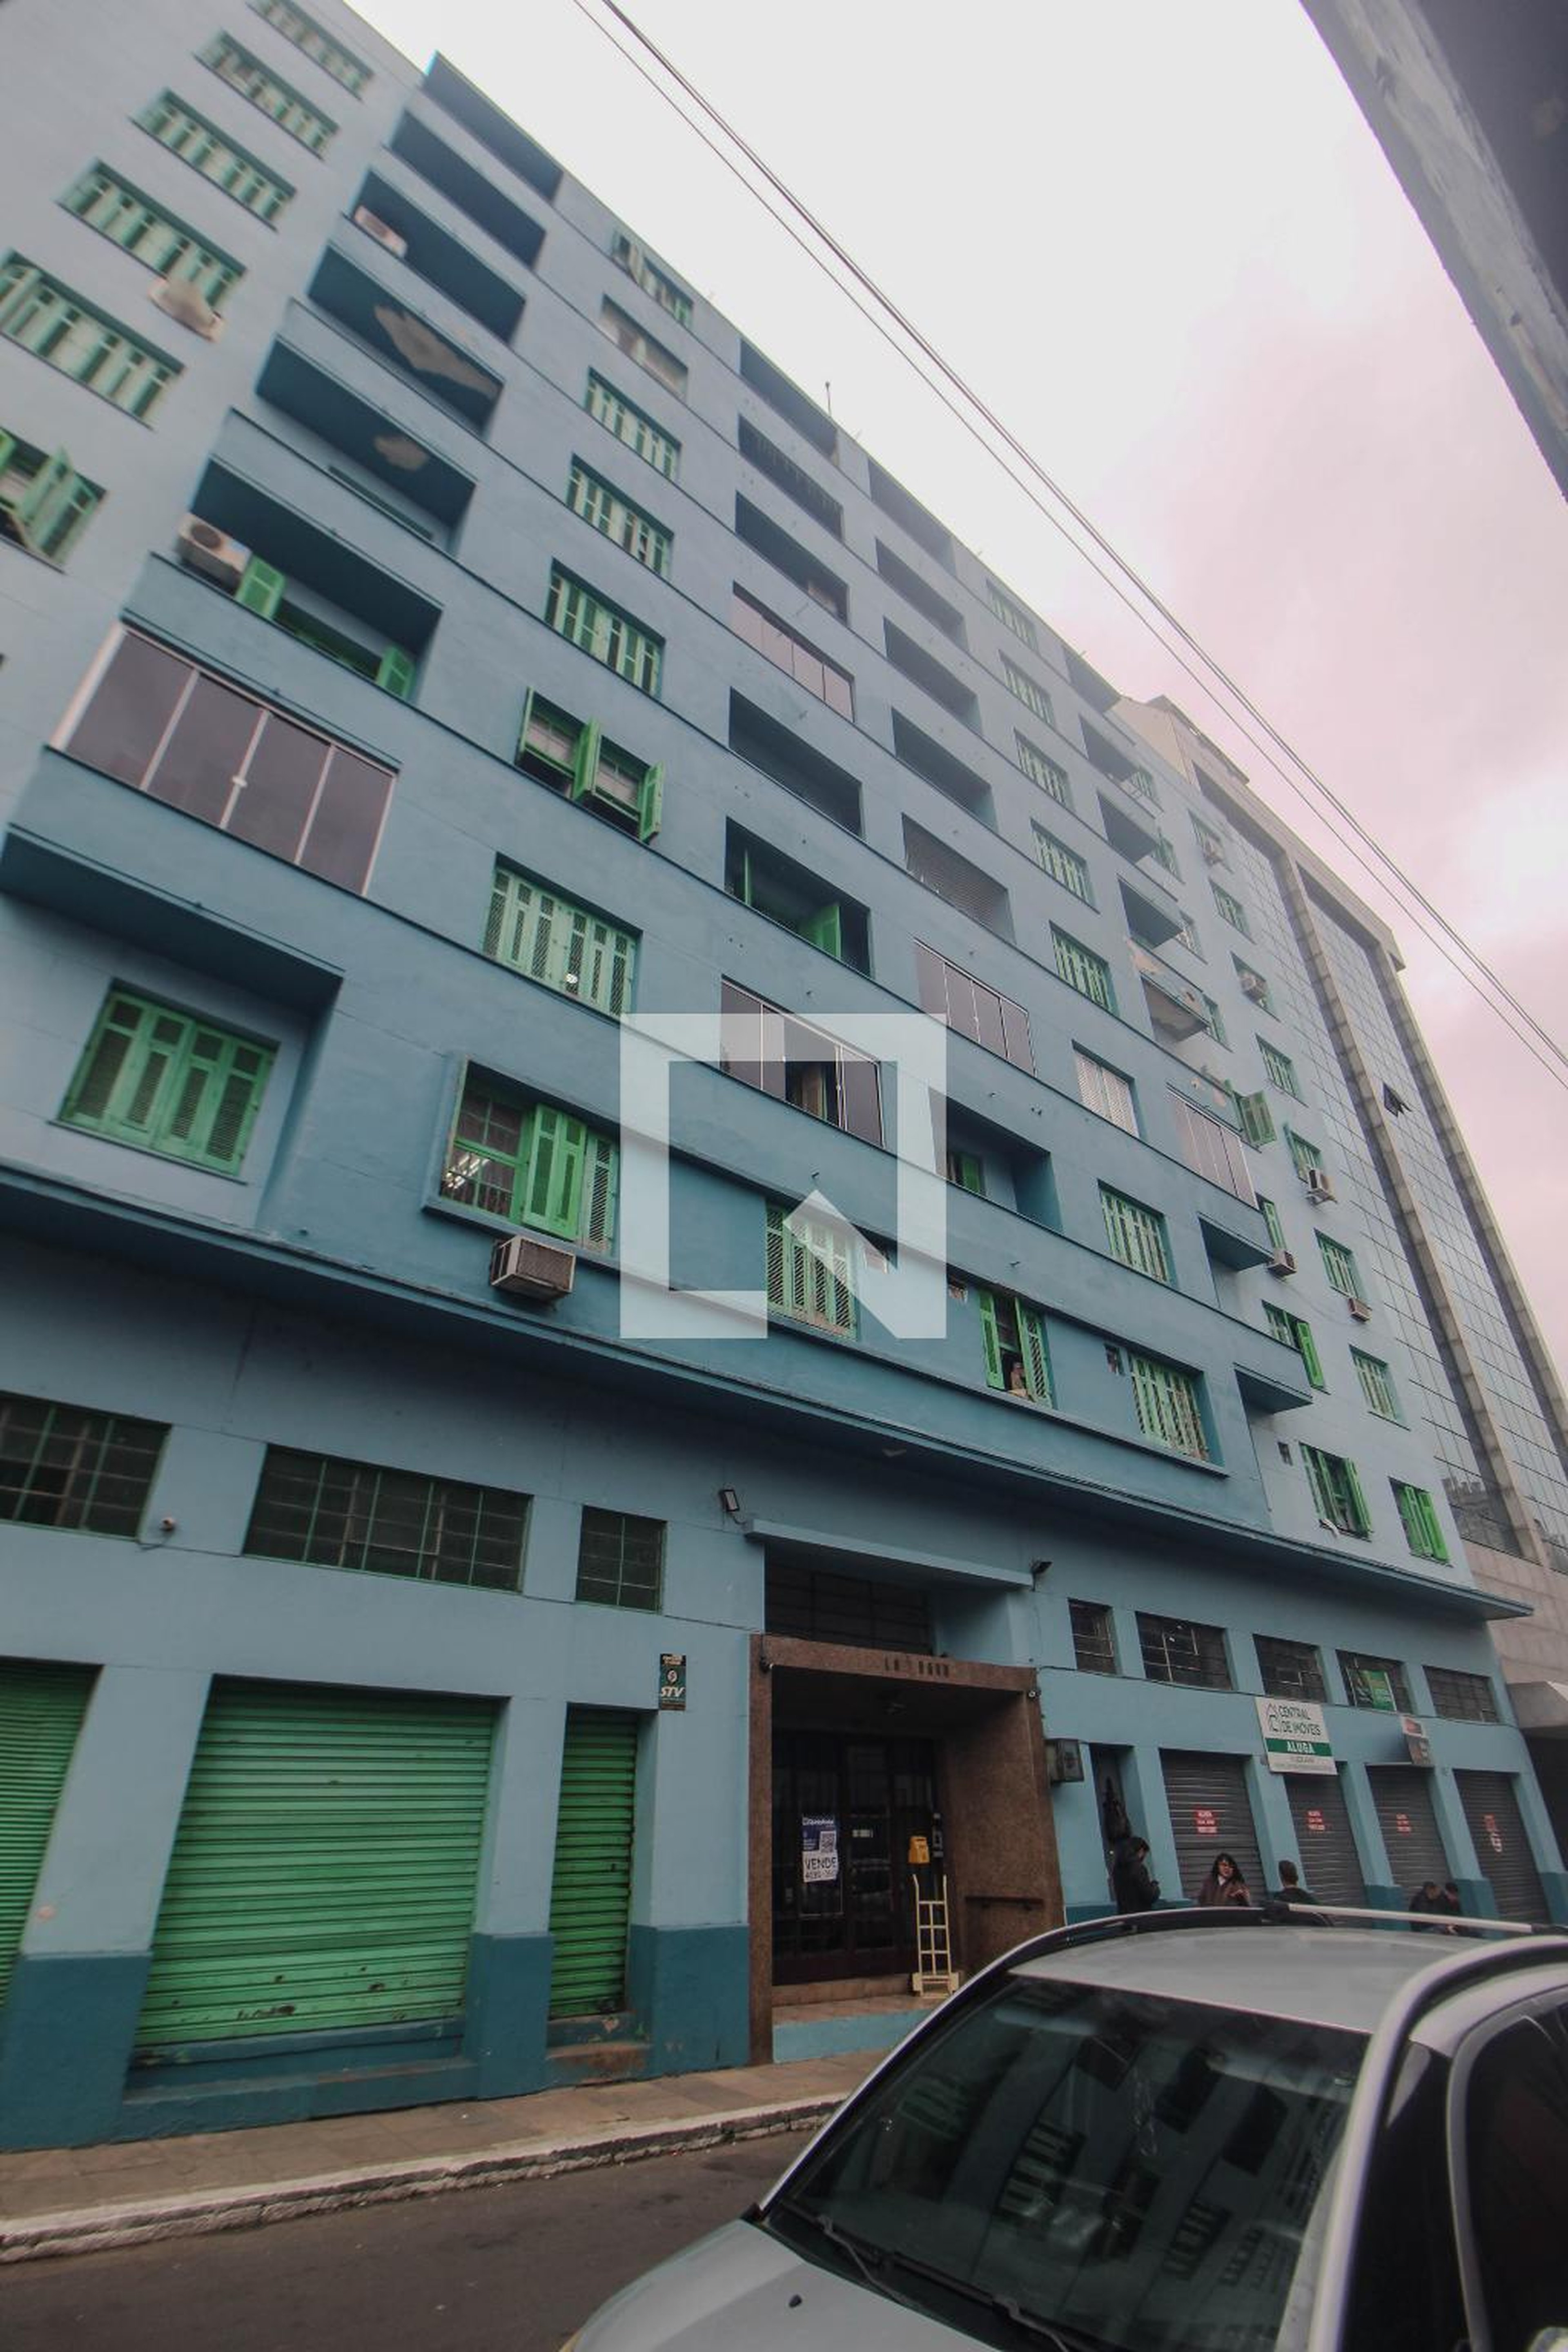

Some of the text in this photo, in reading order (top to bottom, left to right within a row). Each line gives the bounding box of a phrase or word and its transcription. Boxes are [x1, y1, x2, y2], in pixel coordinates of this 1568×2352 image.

[661, 1686, 686, 1697] STV
[1278, 1705, 1311, 1720] CENTRAL
[1282, 1720, 1293, 1733] DE
[1287, 1741, 1315, 1754] ALUGA
[805, 1857, 836, 1870] VENDE
